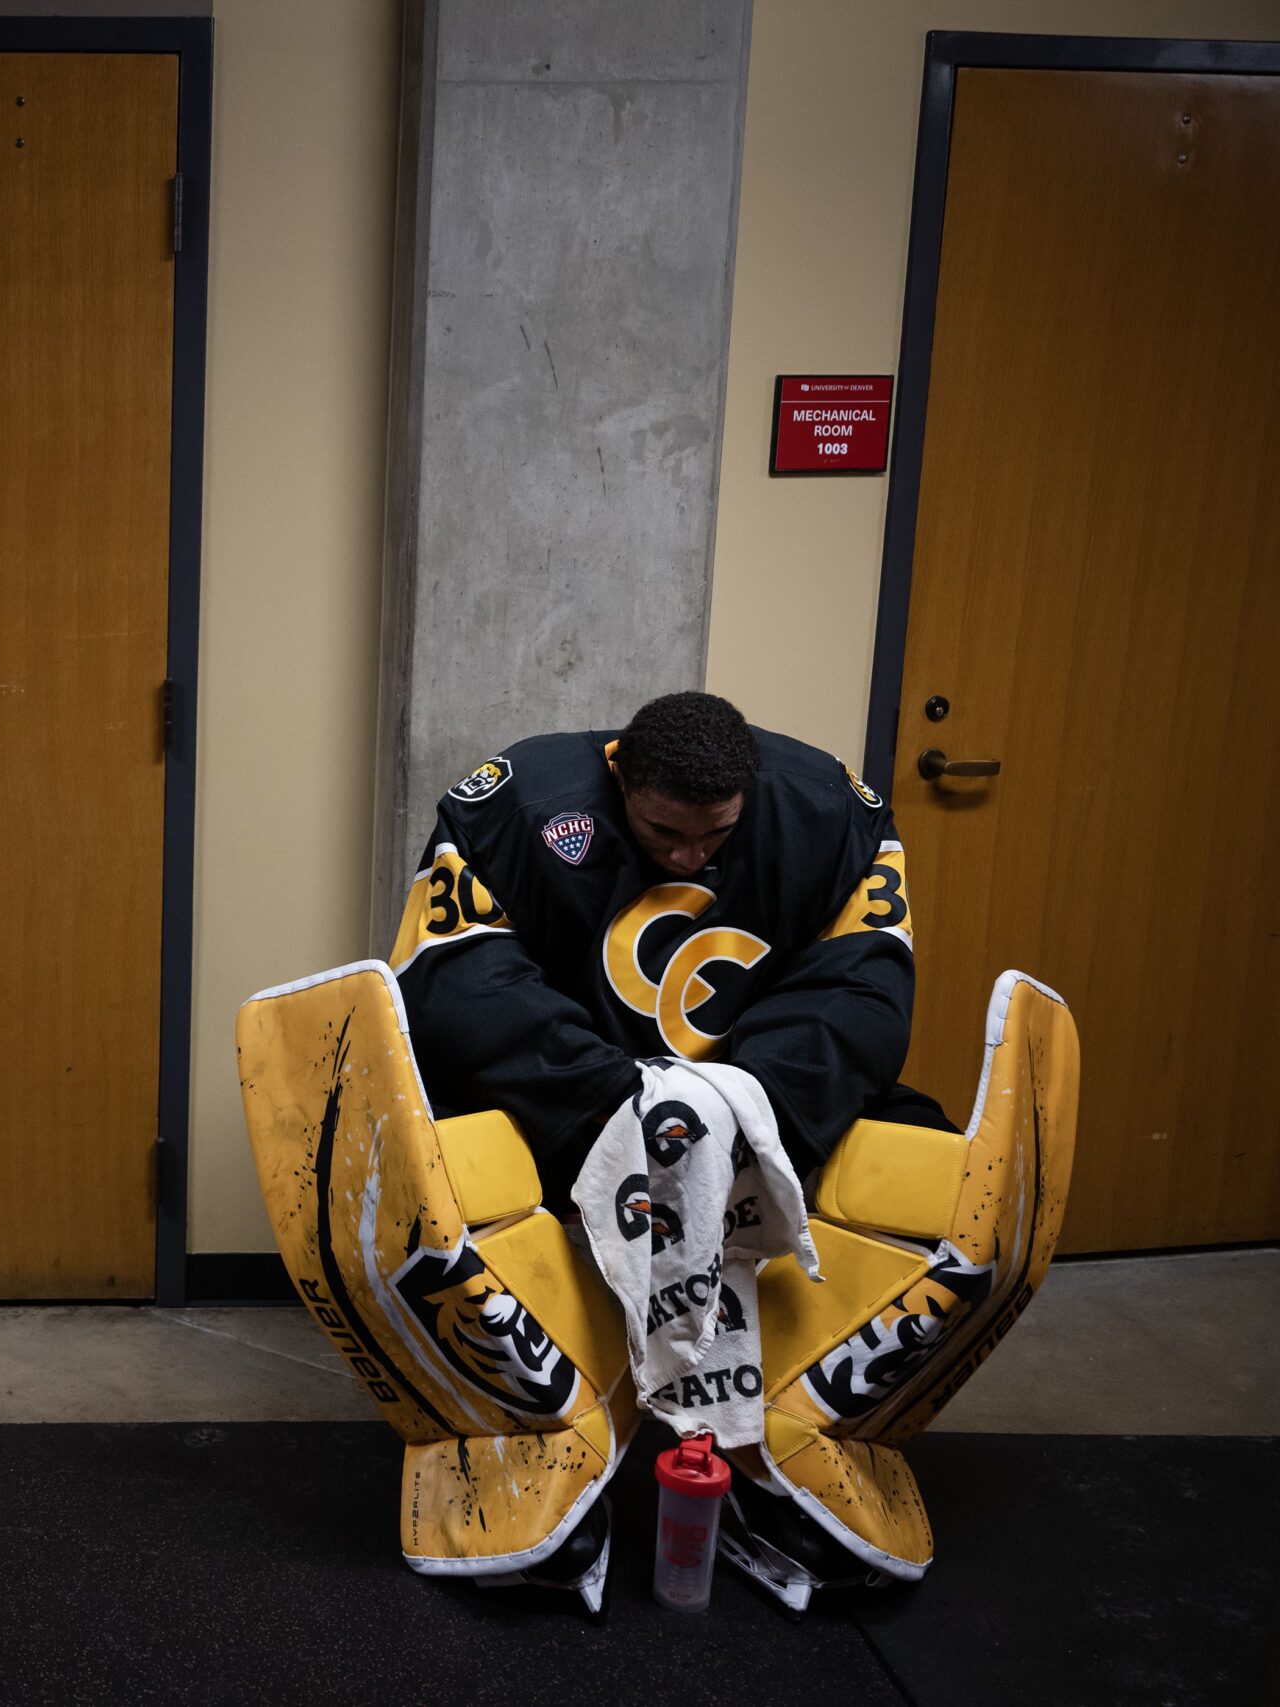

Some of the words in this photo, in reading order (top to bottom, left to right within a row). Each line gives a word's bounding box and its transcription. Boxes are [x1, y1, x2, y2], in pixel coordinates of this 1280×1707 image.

[793, 409, 876, 422] MECHANICAL
[814, 425, 853, 437] ROOM
[817, 443, 848, 455] 1003
[544, 819, 591, 843] NCHC
[425, 866, 505, 935] 30
[861, 863, 908, 929] 3
[298, 1278, 402, 1403] BAUER
